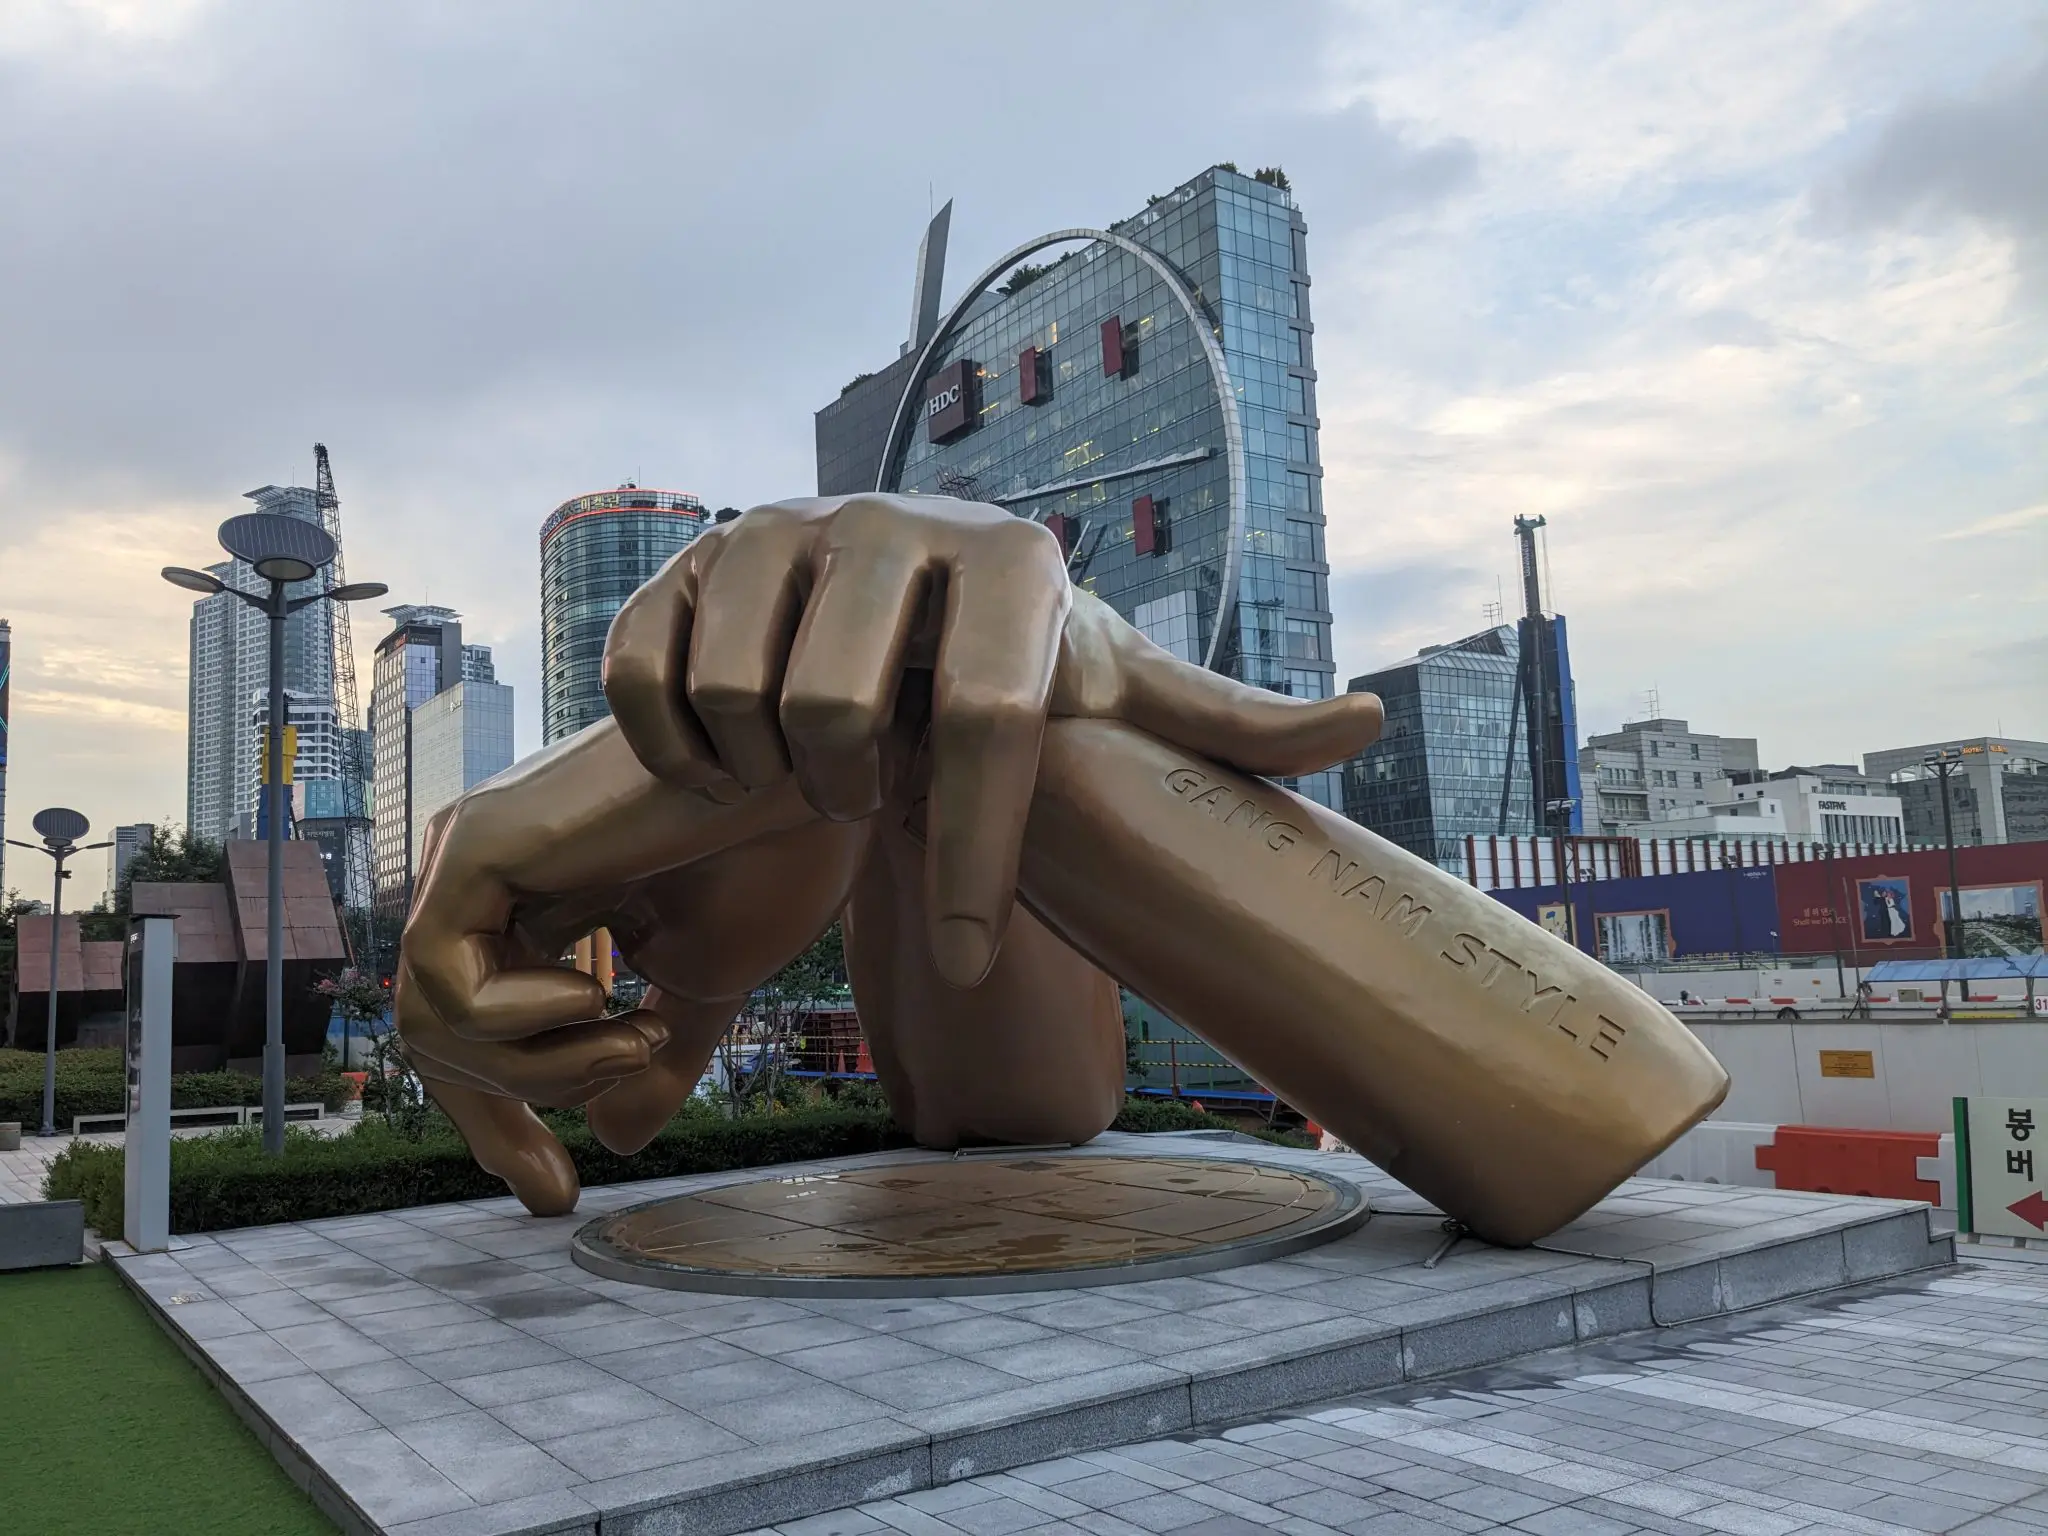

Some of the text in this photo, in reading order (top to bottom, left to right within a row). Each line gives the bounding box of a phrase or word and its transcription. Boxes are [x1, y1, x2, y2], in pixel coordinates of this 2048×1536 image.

[929, 384, 959, 415] HDC
[1818, 800, 1847, 811] FASTFIVE
[1164, 767, 1627, 1063] GANG NAM STYLE
[2006, 1149, 2034, 1182] 버
